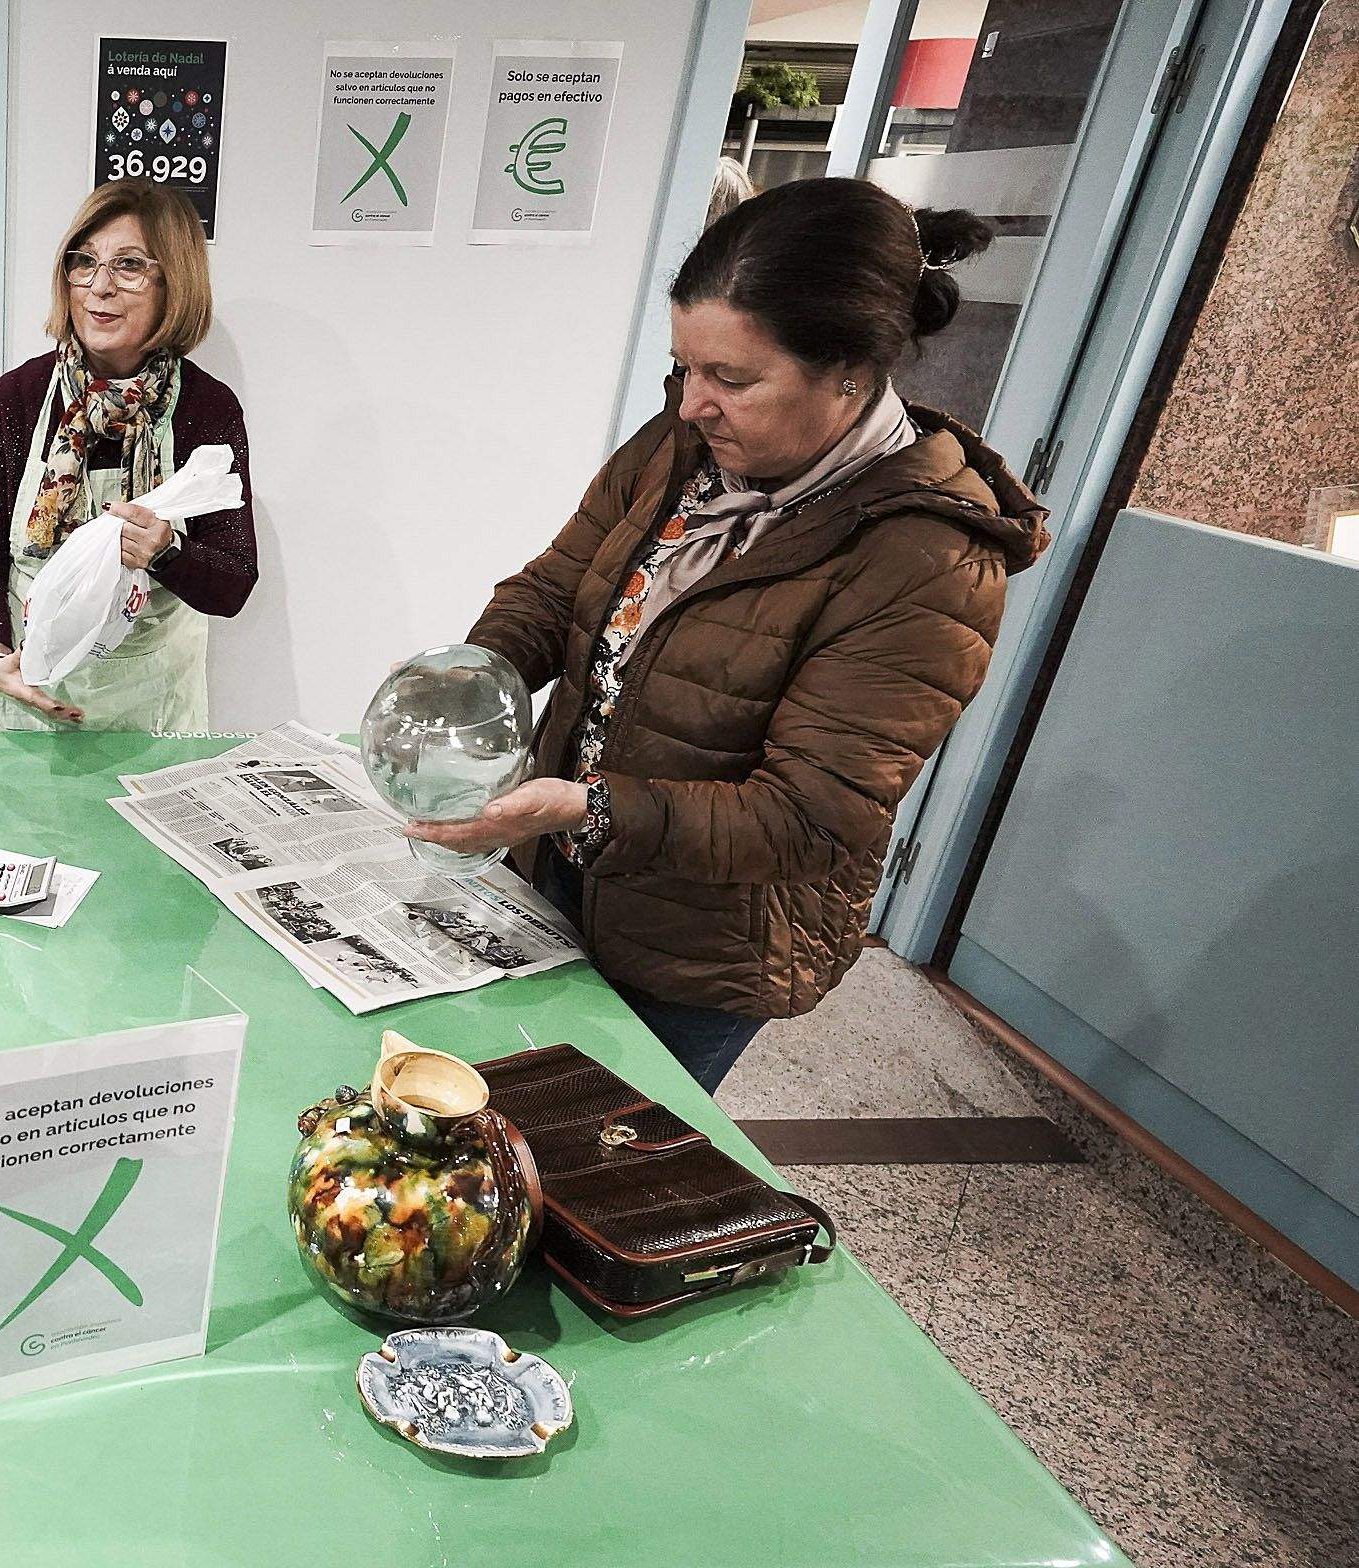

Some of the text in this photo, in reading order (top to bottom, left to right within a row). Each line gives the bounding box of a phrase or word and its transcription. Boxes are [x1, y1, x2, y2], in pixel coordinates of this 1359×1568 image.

[151, 52, 167, 63] de
[169, 52, 204, 65] Nadal
[117, 65, 151, 76] venda
[153, 66, 178, 79] aquí
[330, 69, 444, 80] No se aceptan devoluciones
[507, 70, 601, 86] Solo se aceptan
[335, 83, 358, 92] salvo
[407, 85, 424, 94] que
[425, 85, 436, 93] no
[333, 96, 436, 106] funcionen correctamente
[499, 90, 603, 104] pagos en efectivo
[107, 149, 207, 184] 36.929
[4, 1097, 84, 1120] aceptan
[88, 1077, 214, 1107] devoluciones
[16, 1128, 41, 1142] en
[132, 1106, 169, 1124] que
[173, 1102, 196, 1116] no
[58, 1123, 196, 1157] correctamente
